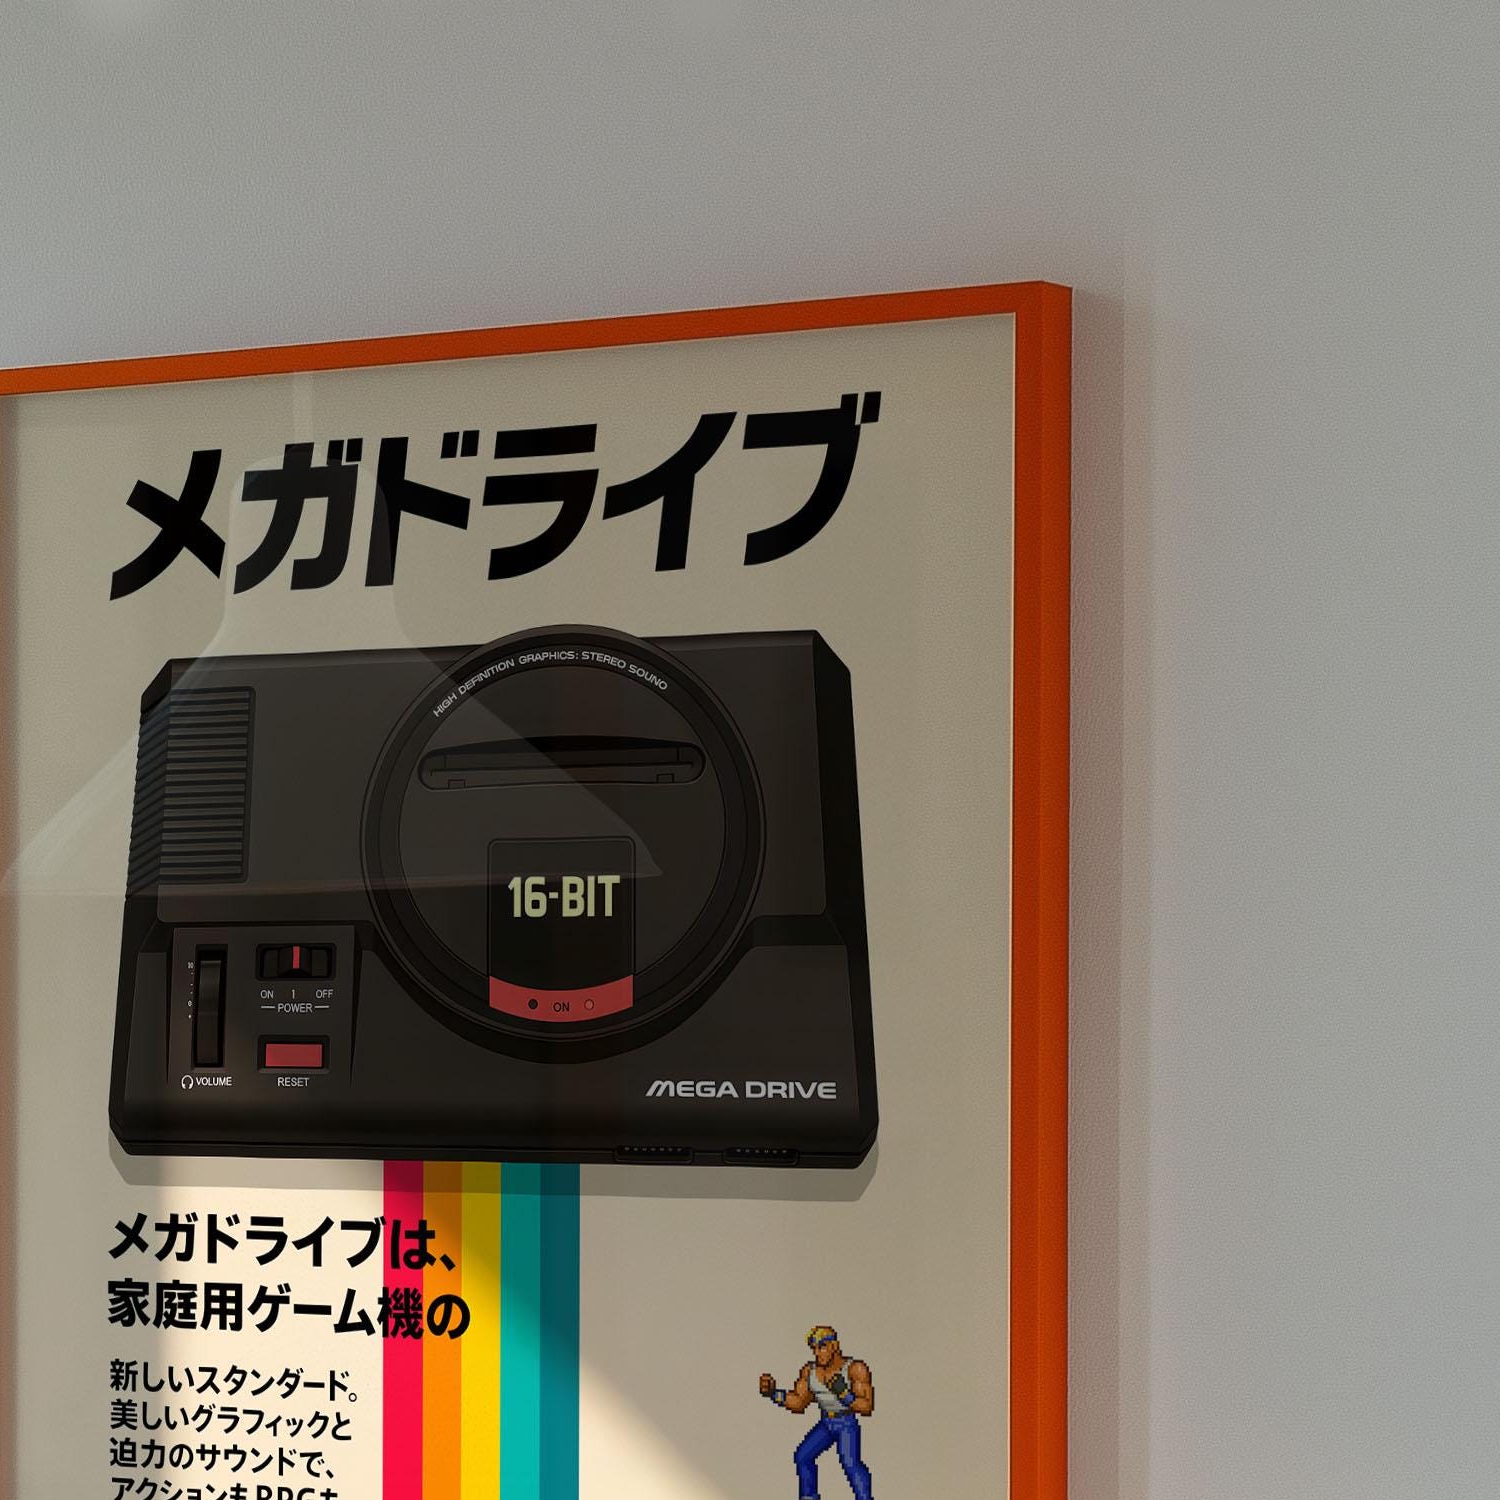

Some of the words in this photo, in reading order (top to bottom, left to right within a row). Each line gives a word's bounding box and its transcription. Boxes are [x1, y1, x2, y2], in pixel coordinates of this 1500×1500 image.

[109, 390, 882, 601] メガドライブ
[433, 694, 457, 717] HIGH
[458, 658, 515, 695] DEFINITION
[518, 650, 579, 665] GRAPHICS:
[581, 651, 627, 670] STEREO
[507, 874, 621, 918] 16-BIT
[260, 990, 274, 999] ON
[315, 989, 334, 999] OFF
[277, 1003, 313, 1013] POWER
[552, 1001, 570, 1013] ON
[196, 1076, 233, 1086] VOLUME
[277, 1077, 310, 1087] RESET
[645, 1080, 739, 1098] MEGA
[745, 1081, 837, 1099] DRIVE
[108, 1211, 457, 1272] メガドライブは、
[107, 1277, 471, 1340] 家庭用ゲーム機の
[109, 1358, 358, 1403] 新しいスタンダード。
[109, 1398, 353, 1441] 美しいグラフィックと
[109, 1437, 336, 1479] 迫力のサウンドで、
